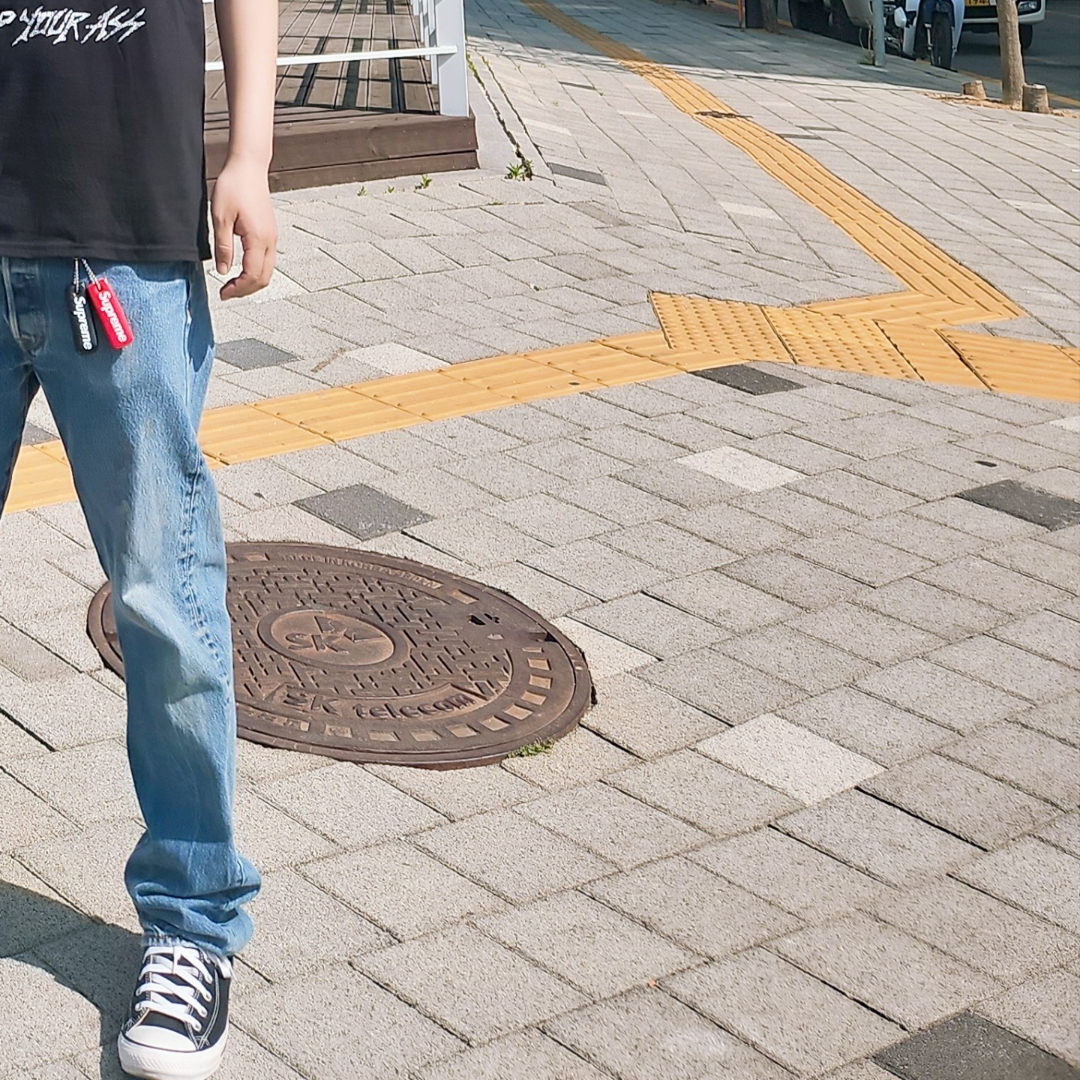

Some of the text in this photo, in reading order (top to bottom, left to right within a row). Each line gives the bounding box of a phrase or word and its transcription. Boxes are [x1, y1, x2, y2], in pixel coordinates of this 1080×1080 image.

[12, 5, 91, 46] YOUR
[80, 5, 146, 44] ASS
[73, 294, 93, 351] Supreme
[99, 289, 127, 343] Supreme
[284, 633, 344, 653] SK
[283, 690, 477, 719] SK telecom
